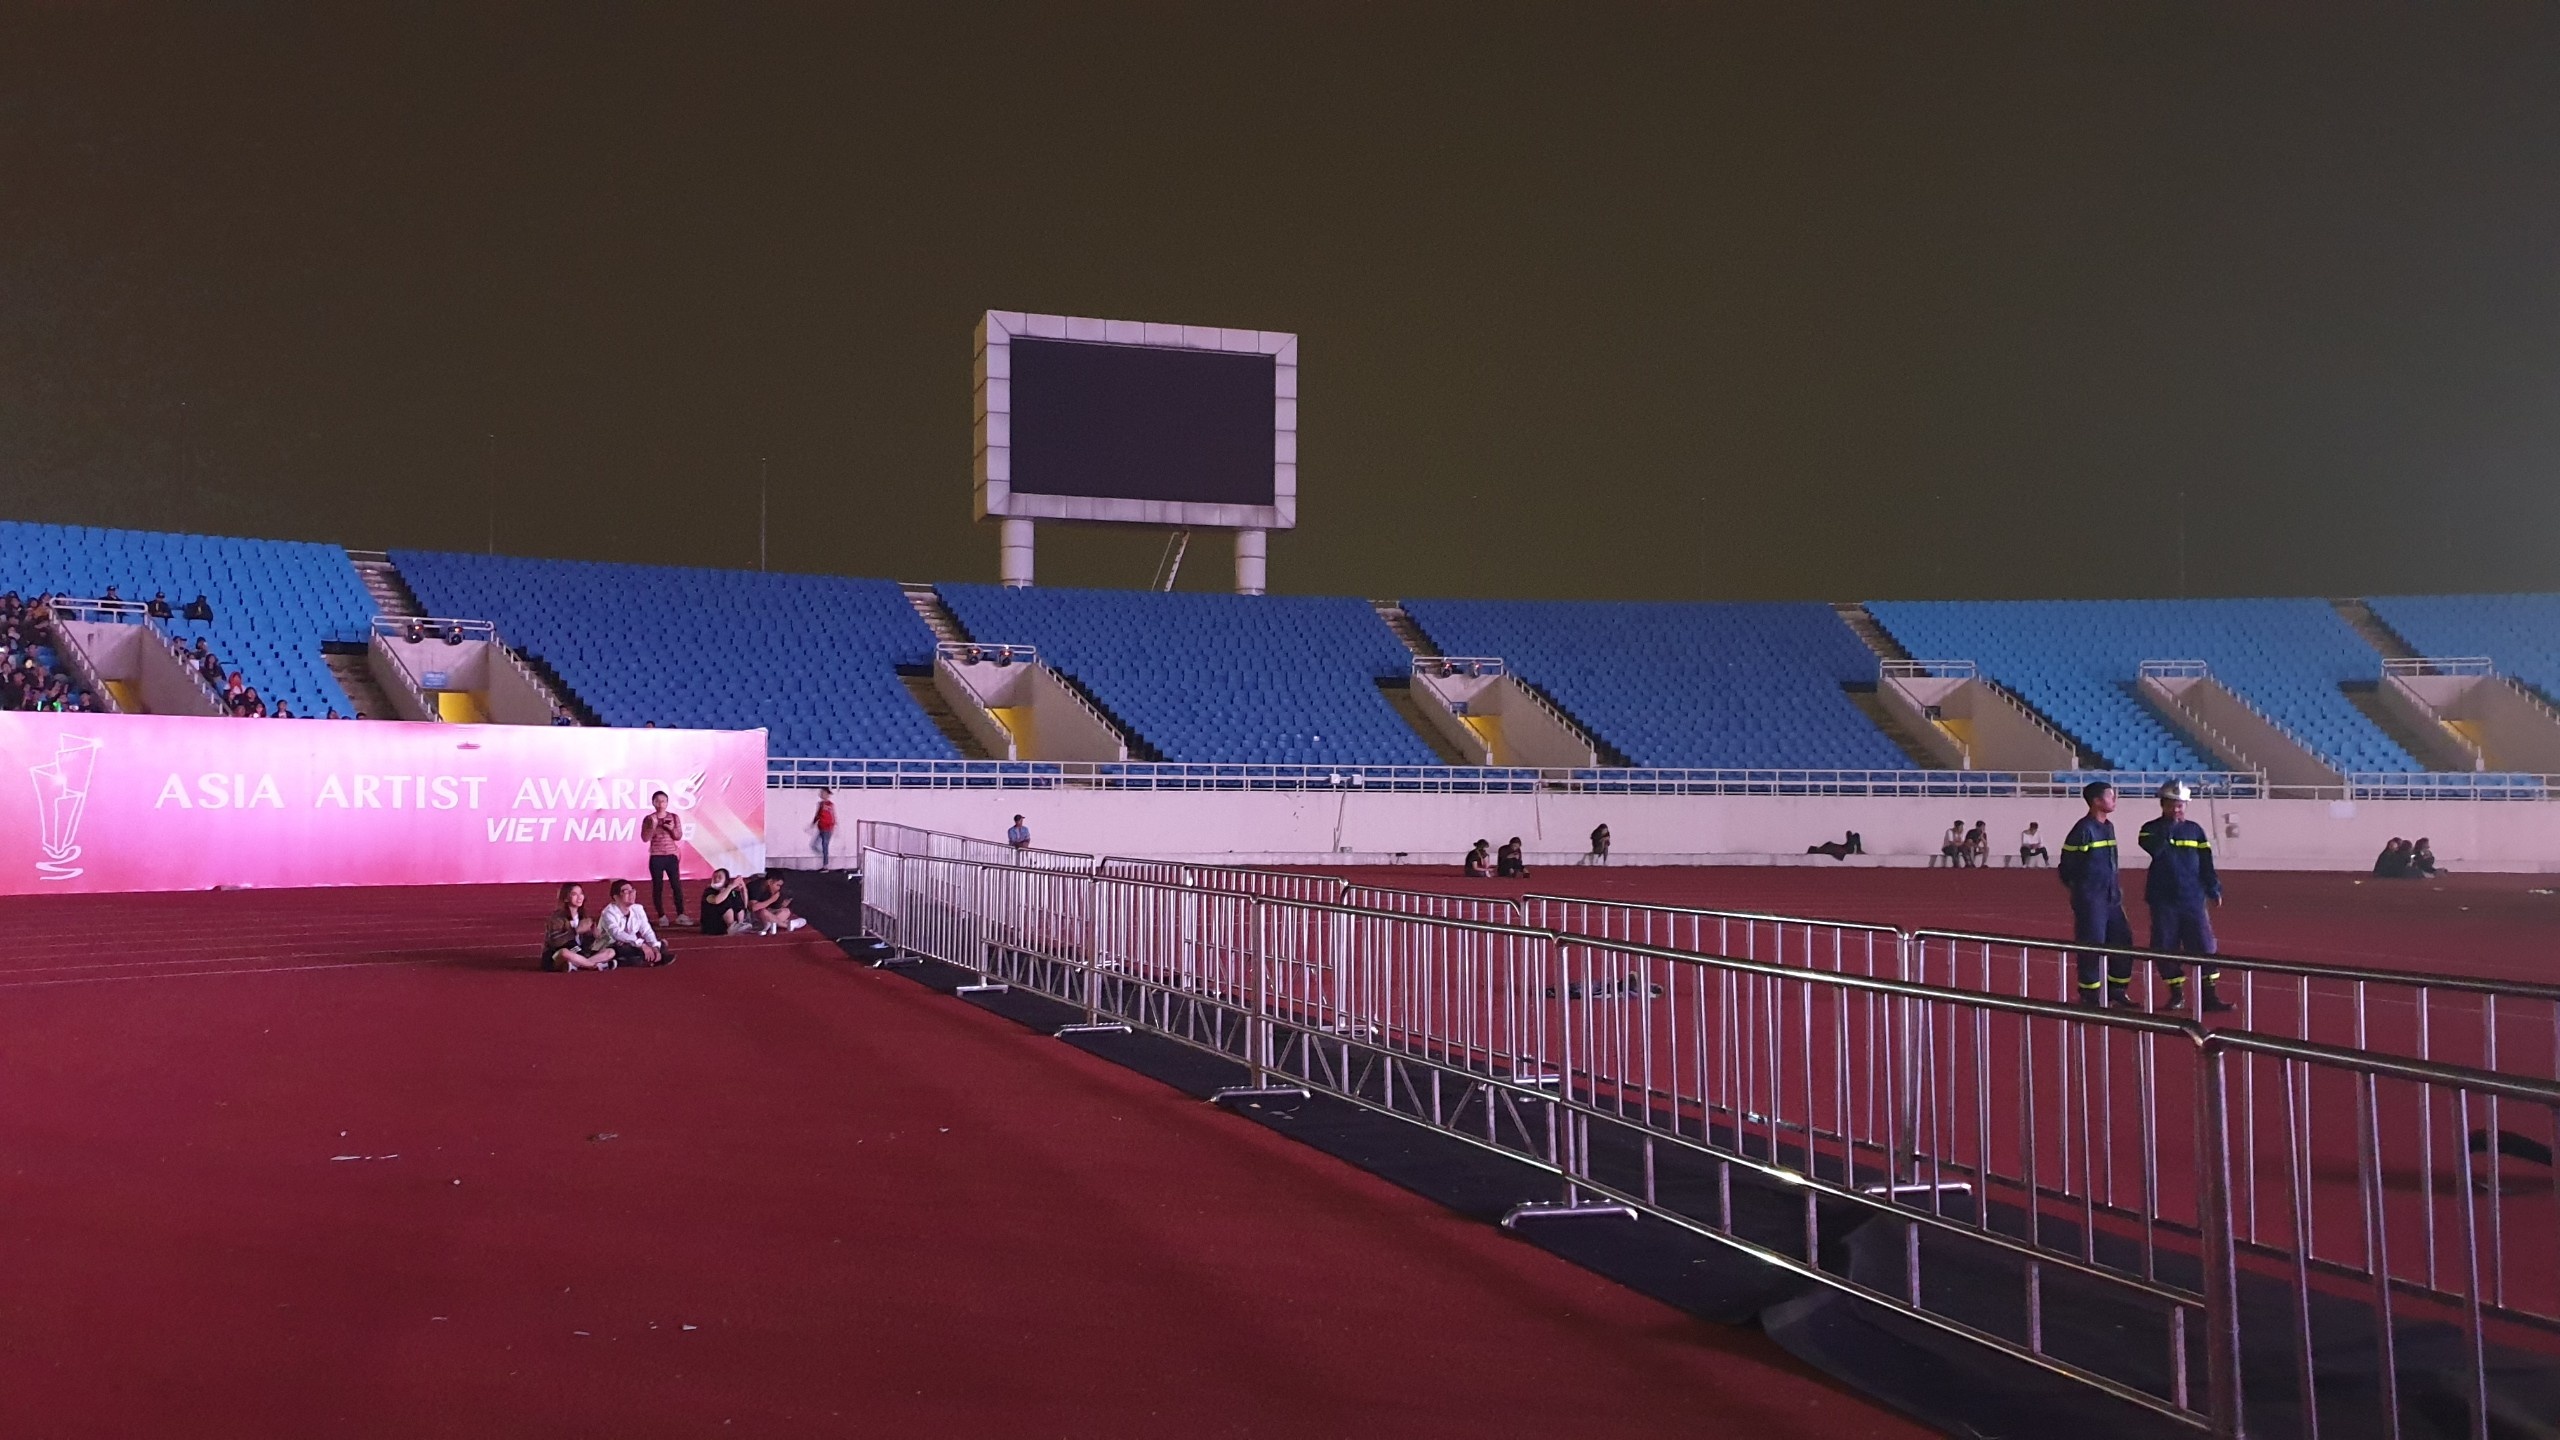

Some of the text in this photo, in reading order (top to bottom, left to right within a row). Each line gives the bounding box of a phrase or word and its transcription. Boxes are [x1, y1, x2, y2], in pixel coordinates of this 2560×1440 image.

[154, 772, 701, 811] ASIA ARTIST AWARDS
[487, 816, 636, 843] VIET NAM
